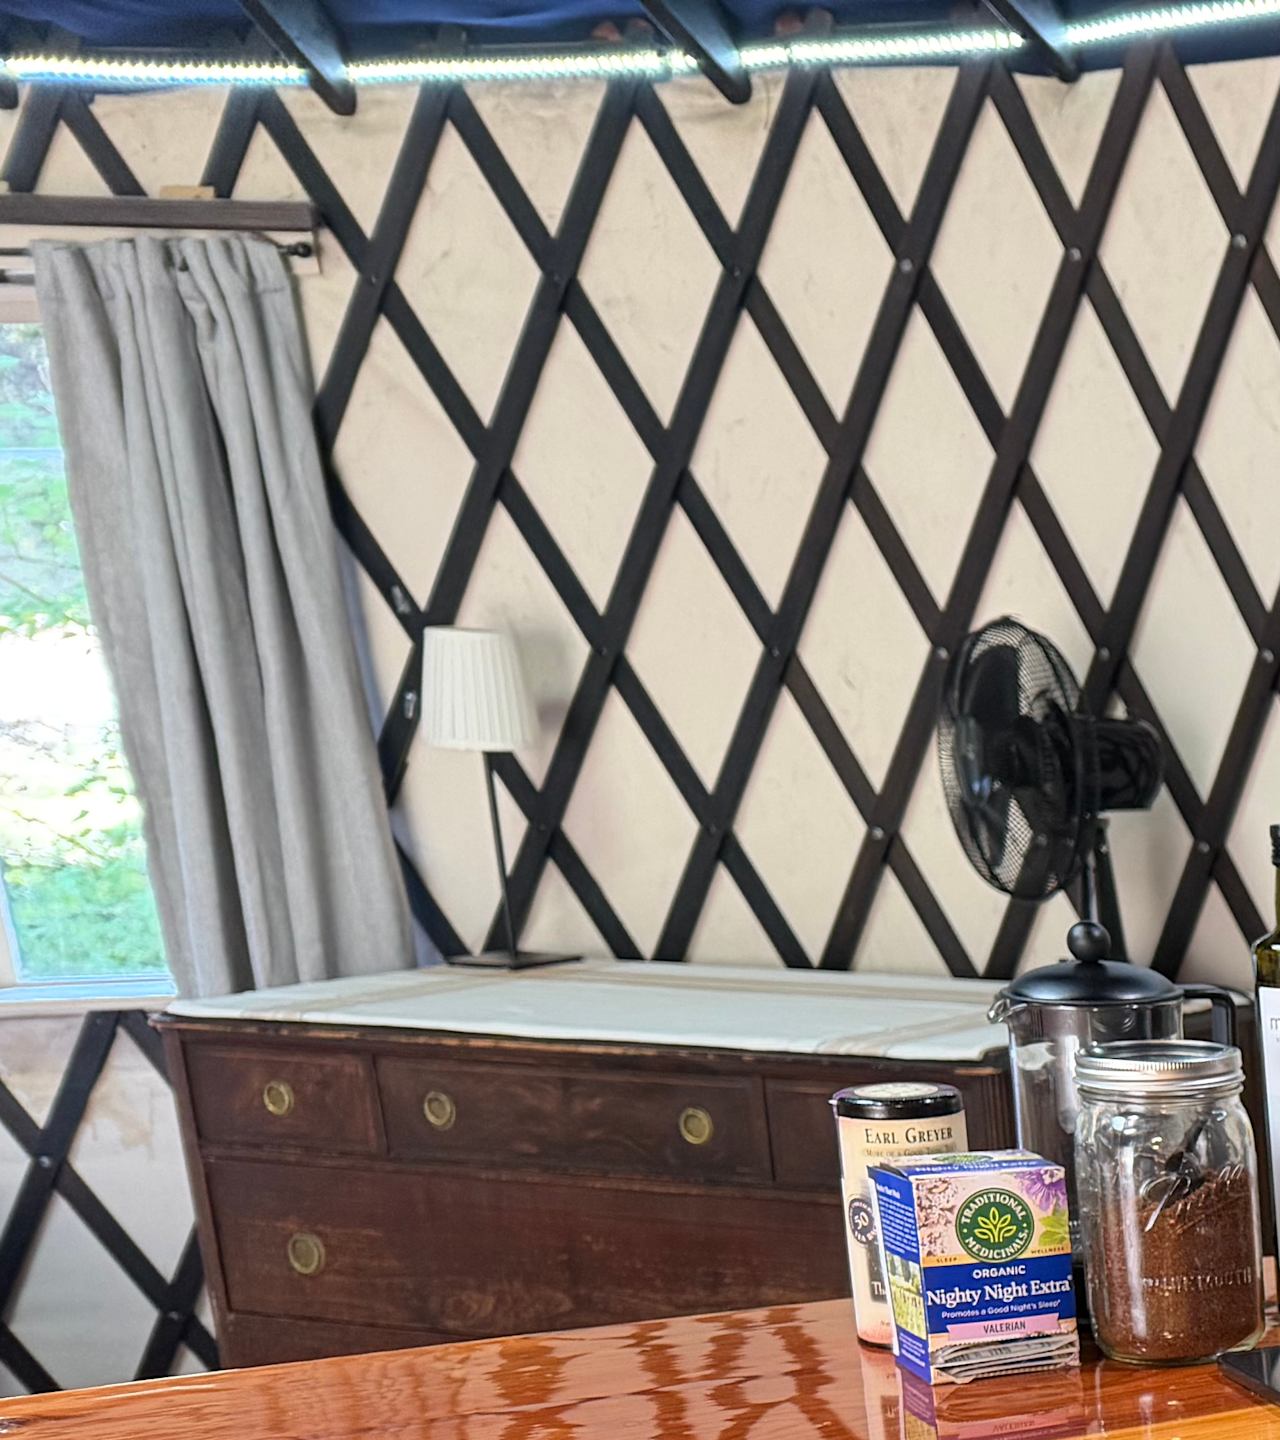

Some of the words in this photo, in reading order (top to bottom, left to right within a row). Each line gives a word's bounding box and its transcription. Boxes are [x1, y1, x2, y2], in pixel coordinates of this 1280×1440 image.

[864, 1128, 899, 1144] EARL
[905, 1127, 953, 1143] GREYER
[961, 1193, 1026, 1224] TRADITIONAL
[854, 1211, 869, 1230] 50
[965, 1231, 1028, 1259] MEDICINALS
[972, 1265, 1026, 1279] ORGANIC
[926, 1287, 981, 1308] Nighty
[984, 1281, 1028, 1302] Night
[1030, 1280, 1070, 1295] Extra
[942, 1309, 979, 1318] Promotes
[987, 1305, 1009, 1314] Good
[1010, 1303, 1037, 1313] Night's
[983, 1321, 1026, 1334] VALERIAN
